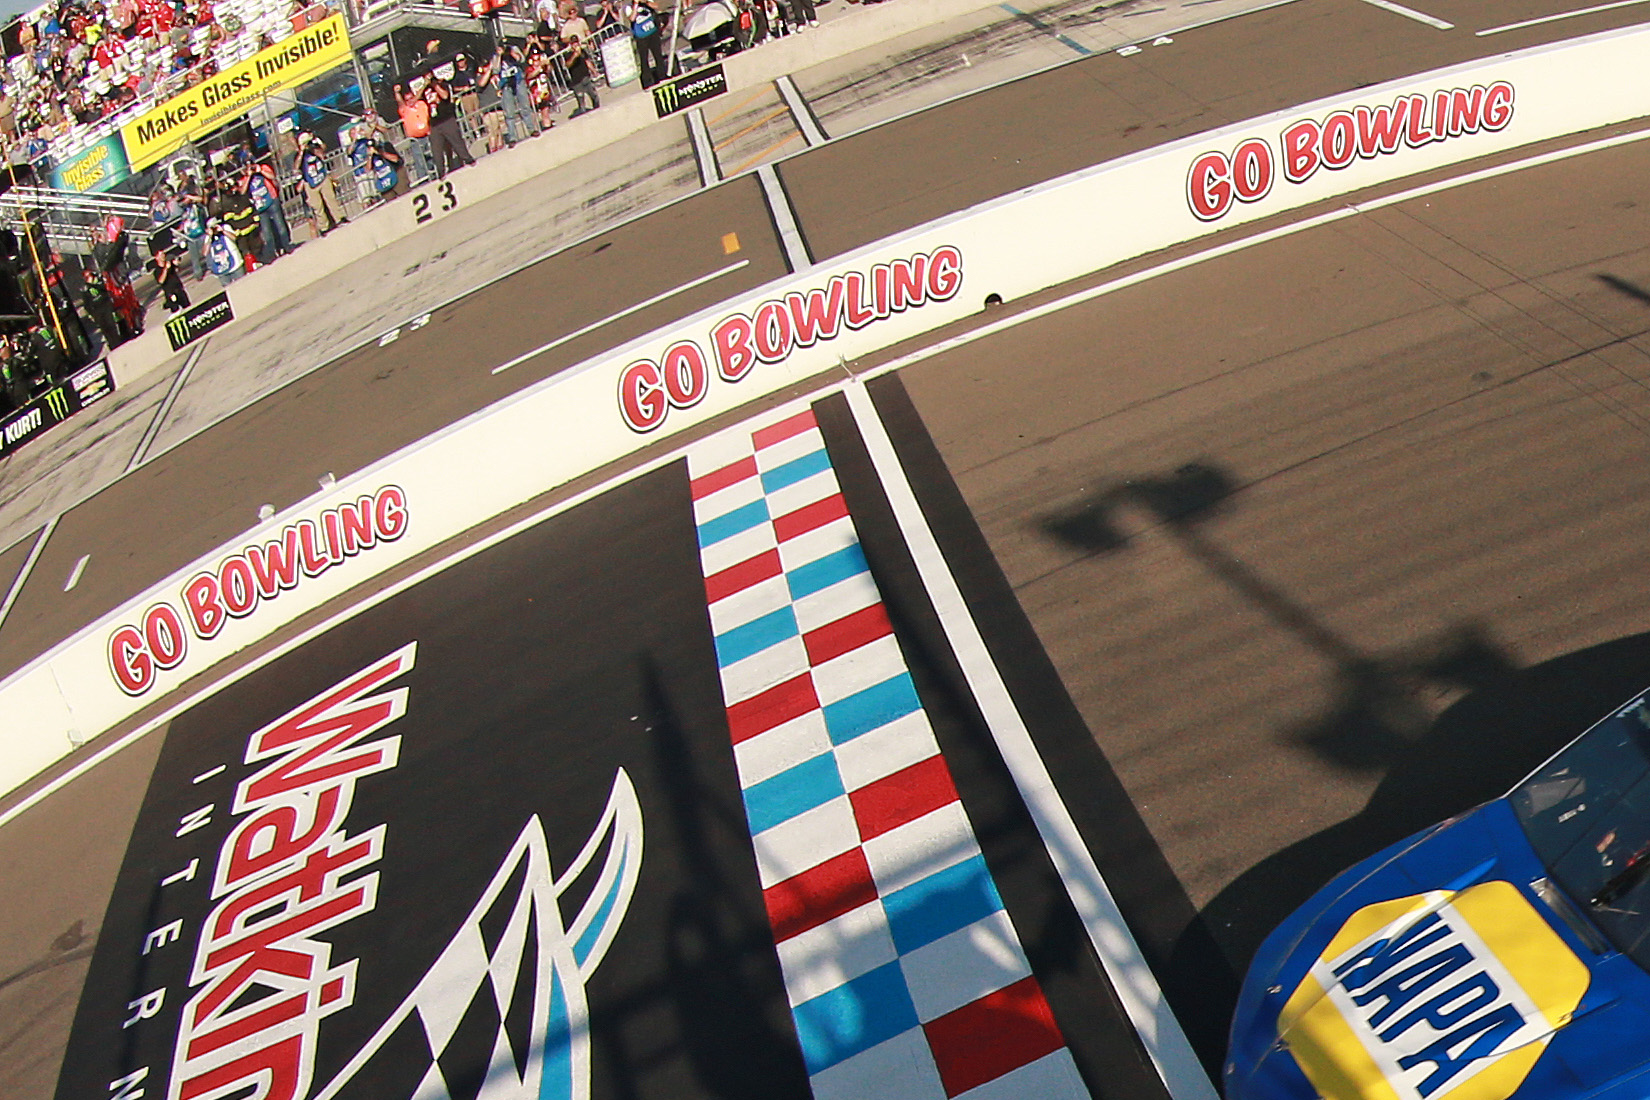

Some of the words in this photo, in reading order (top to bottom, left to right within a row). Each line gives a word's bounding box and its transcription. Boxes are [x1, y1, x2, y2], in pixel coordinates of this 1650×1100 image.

[136, 100, 199, 146] Makes
[201, 71, 252, 108] Glass
[255, 21, 341, 80] Invisible!
[1186, 138, 1275, 222] GO
[1280, 81, 1515, 184] BOWLING
[62, 145, 109, 187] Invisible
[618, 340, 708, 434] GO
[709, 245, 963, 383] BOWLING
[4, 407, 42, 445] KURT!
[107, 602, 188, 697] GO
[181, 484, 409, 640] BOWLING
[1331, 910, 1528, 1100] NAPA
